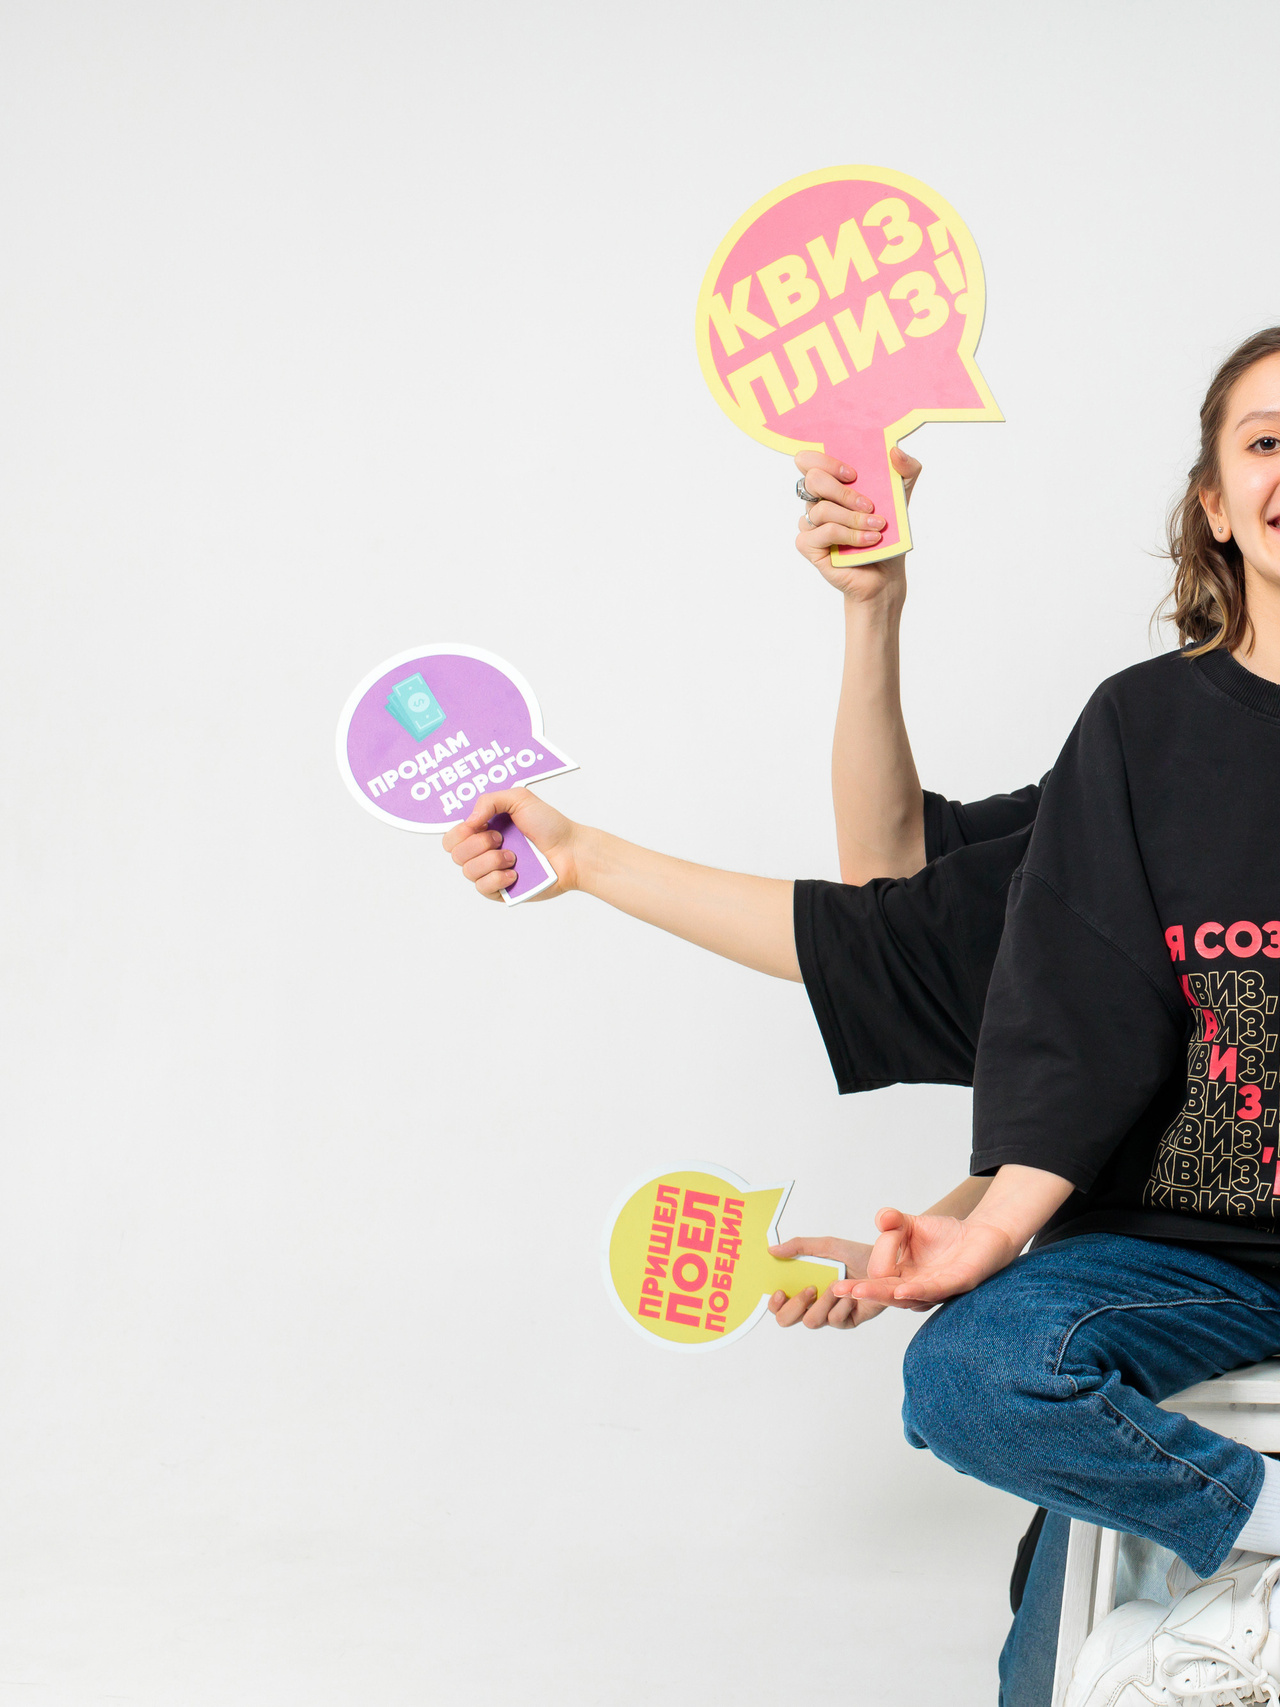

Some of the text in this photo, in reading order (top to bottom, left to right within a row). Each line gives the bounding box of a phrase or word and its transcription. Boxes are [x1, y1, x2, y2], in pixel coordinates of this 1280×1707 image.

[710, 197, 949, 357] КВИЗ,
[726, 251, 970, 426] ПЛИЗ!
[366, 730, 470, 797] ПРОДАМ
[410, 740, 511, 801] ОТВЕТЫ.
[439, 748, 544, 816] ДОРОГО.
[1164, 925, 1186, 961] Я
[638, 1184, 681, 1319] ПРИШЕЛ
[665, 1189, 720, 1328] ПОЕЛ
[705, 1197, 745, 1333] ПОБЕДИЛ
